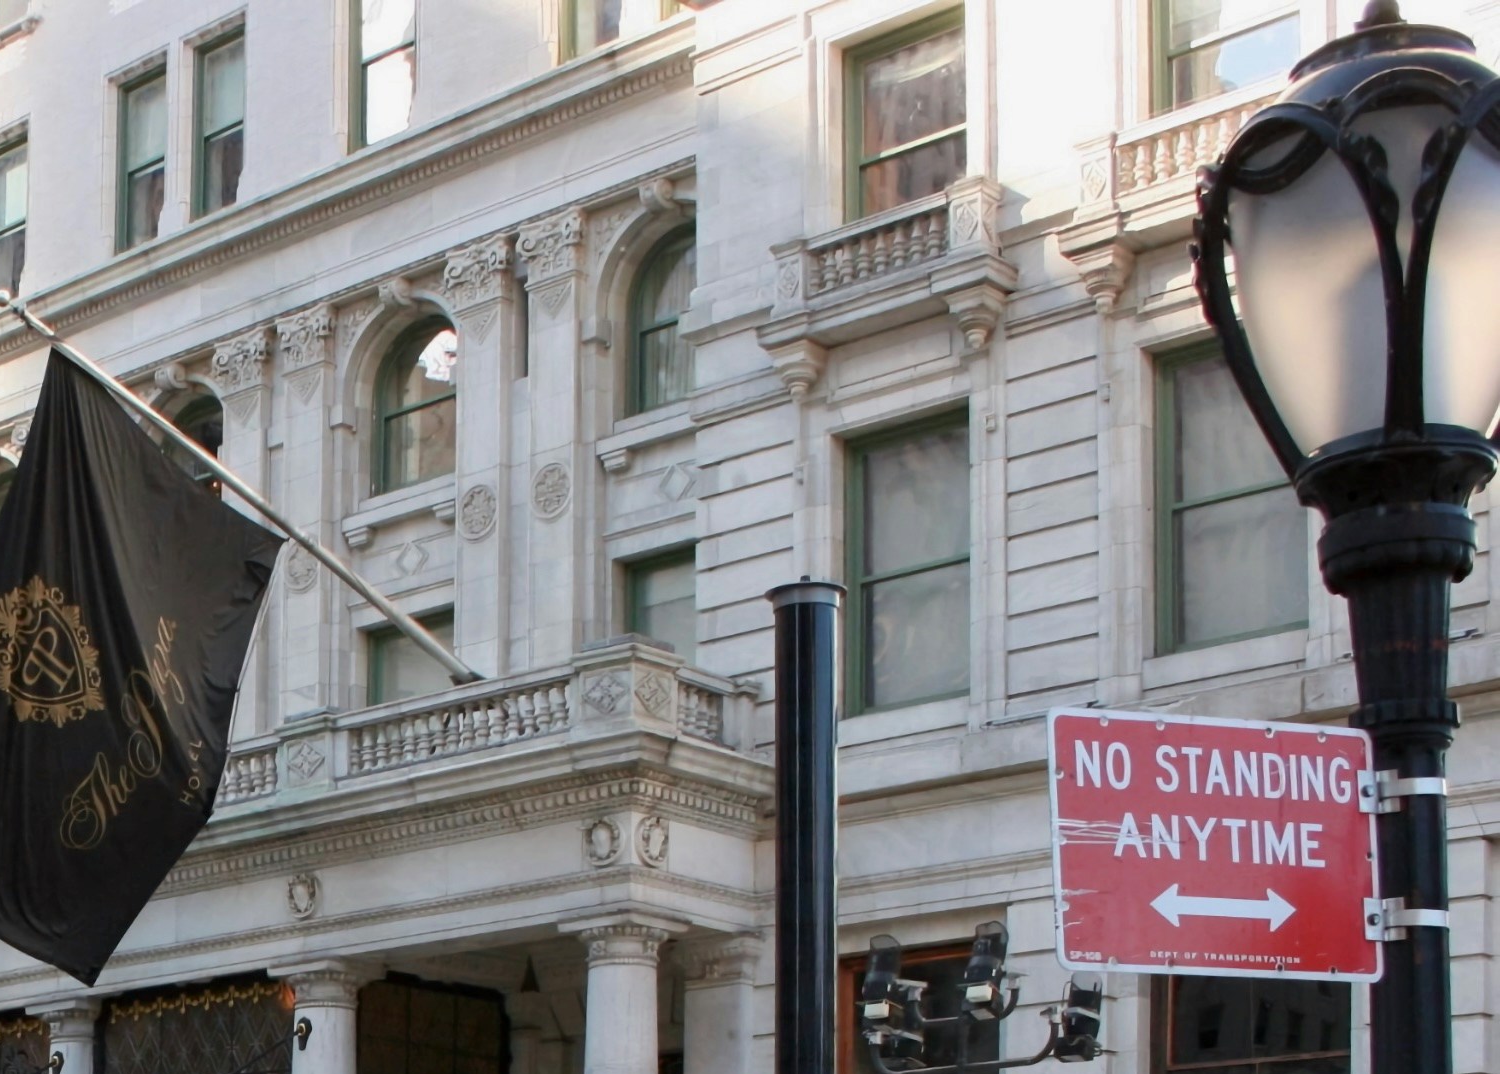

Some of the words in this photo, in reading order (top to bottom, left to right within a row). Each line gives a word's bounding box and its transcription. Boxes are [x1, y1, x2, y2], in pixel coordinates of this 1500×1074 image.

[60, 751, 137, 850] The
[180, 739, 203, 806] HOEL
[1074, 739, 1132, 790] NO
[1155, 744, 1352, 805] STANDING
[1113, 811, 1327, 868] ANYTIME
